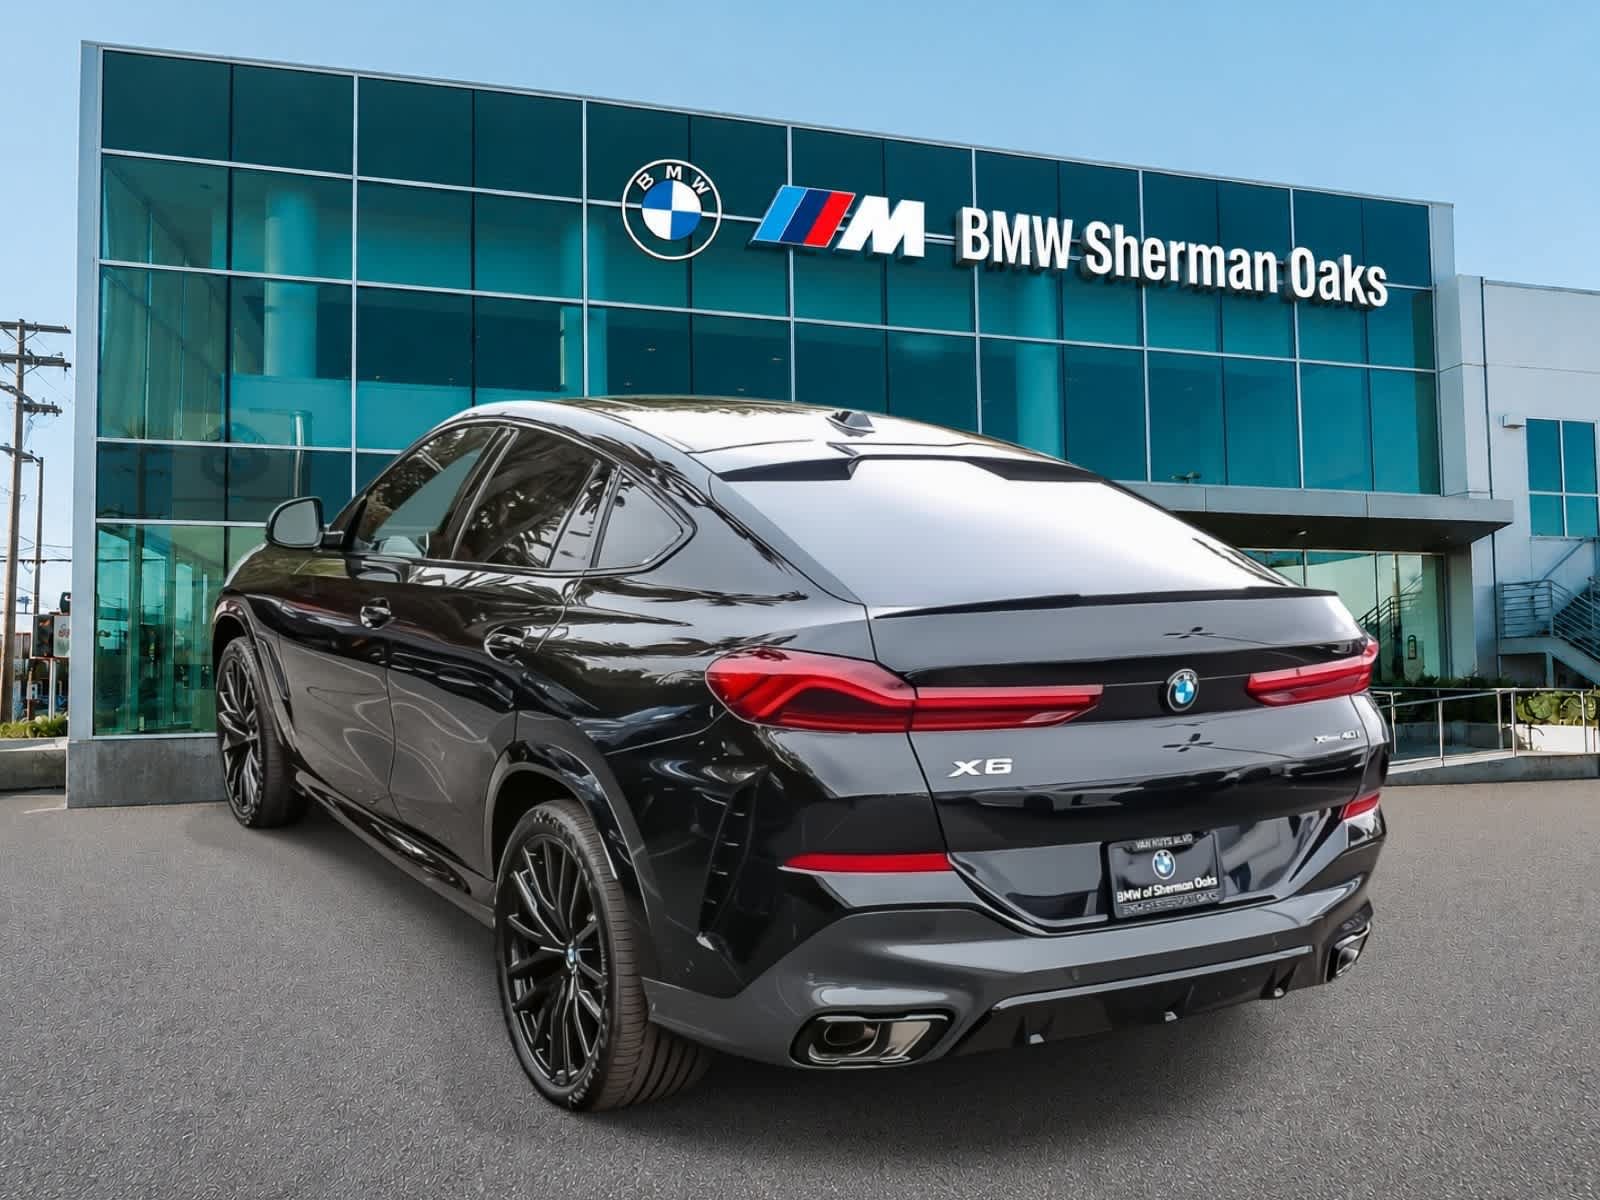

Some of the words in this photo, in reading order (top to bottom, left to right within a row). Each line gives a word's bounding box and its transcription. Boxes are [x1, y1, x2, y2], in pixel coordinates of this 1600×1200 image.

[636, 165, 711, 195] BMW
[961, 206, 1074, 270] BMW
[1084, 219, 1278, 294] Sherman
[1288, 247, 1389, 307] Oaks
[946, 758, 1013, 777] X6
[1116, 888, 1141, 903] BMW
[1143, 887, 1153, 898] of
[1154, 881, 1194, 896] Sherman
[1194, 875, 1218, 889] Oaks
